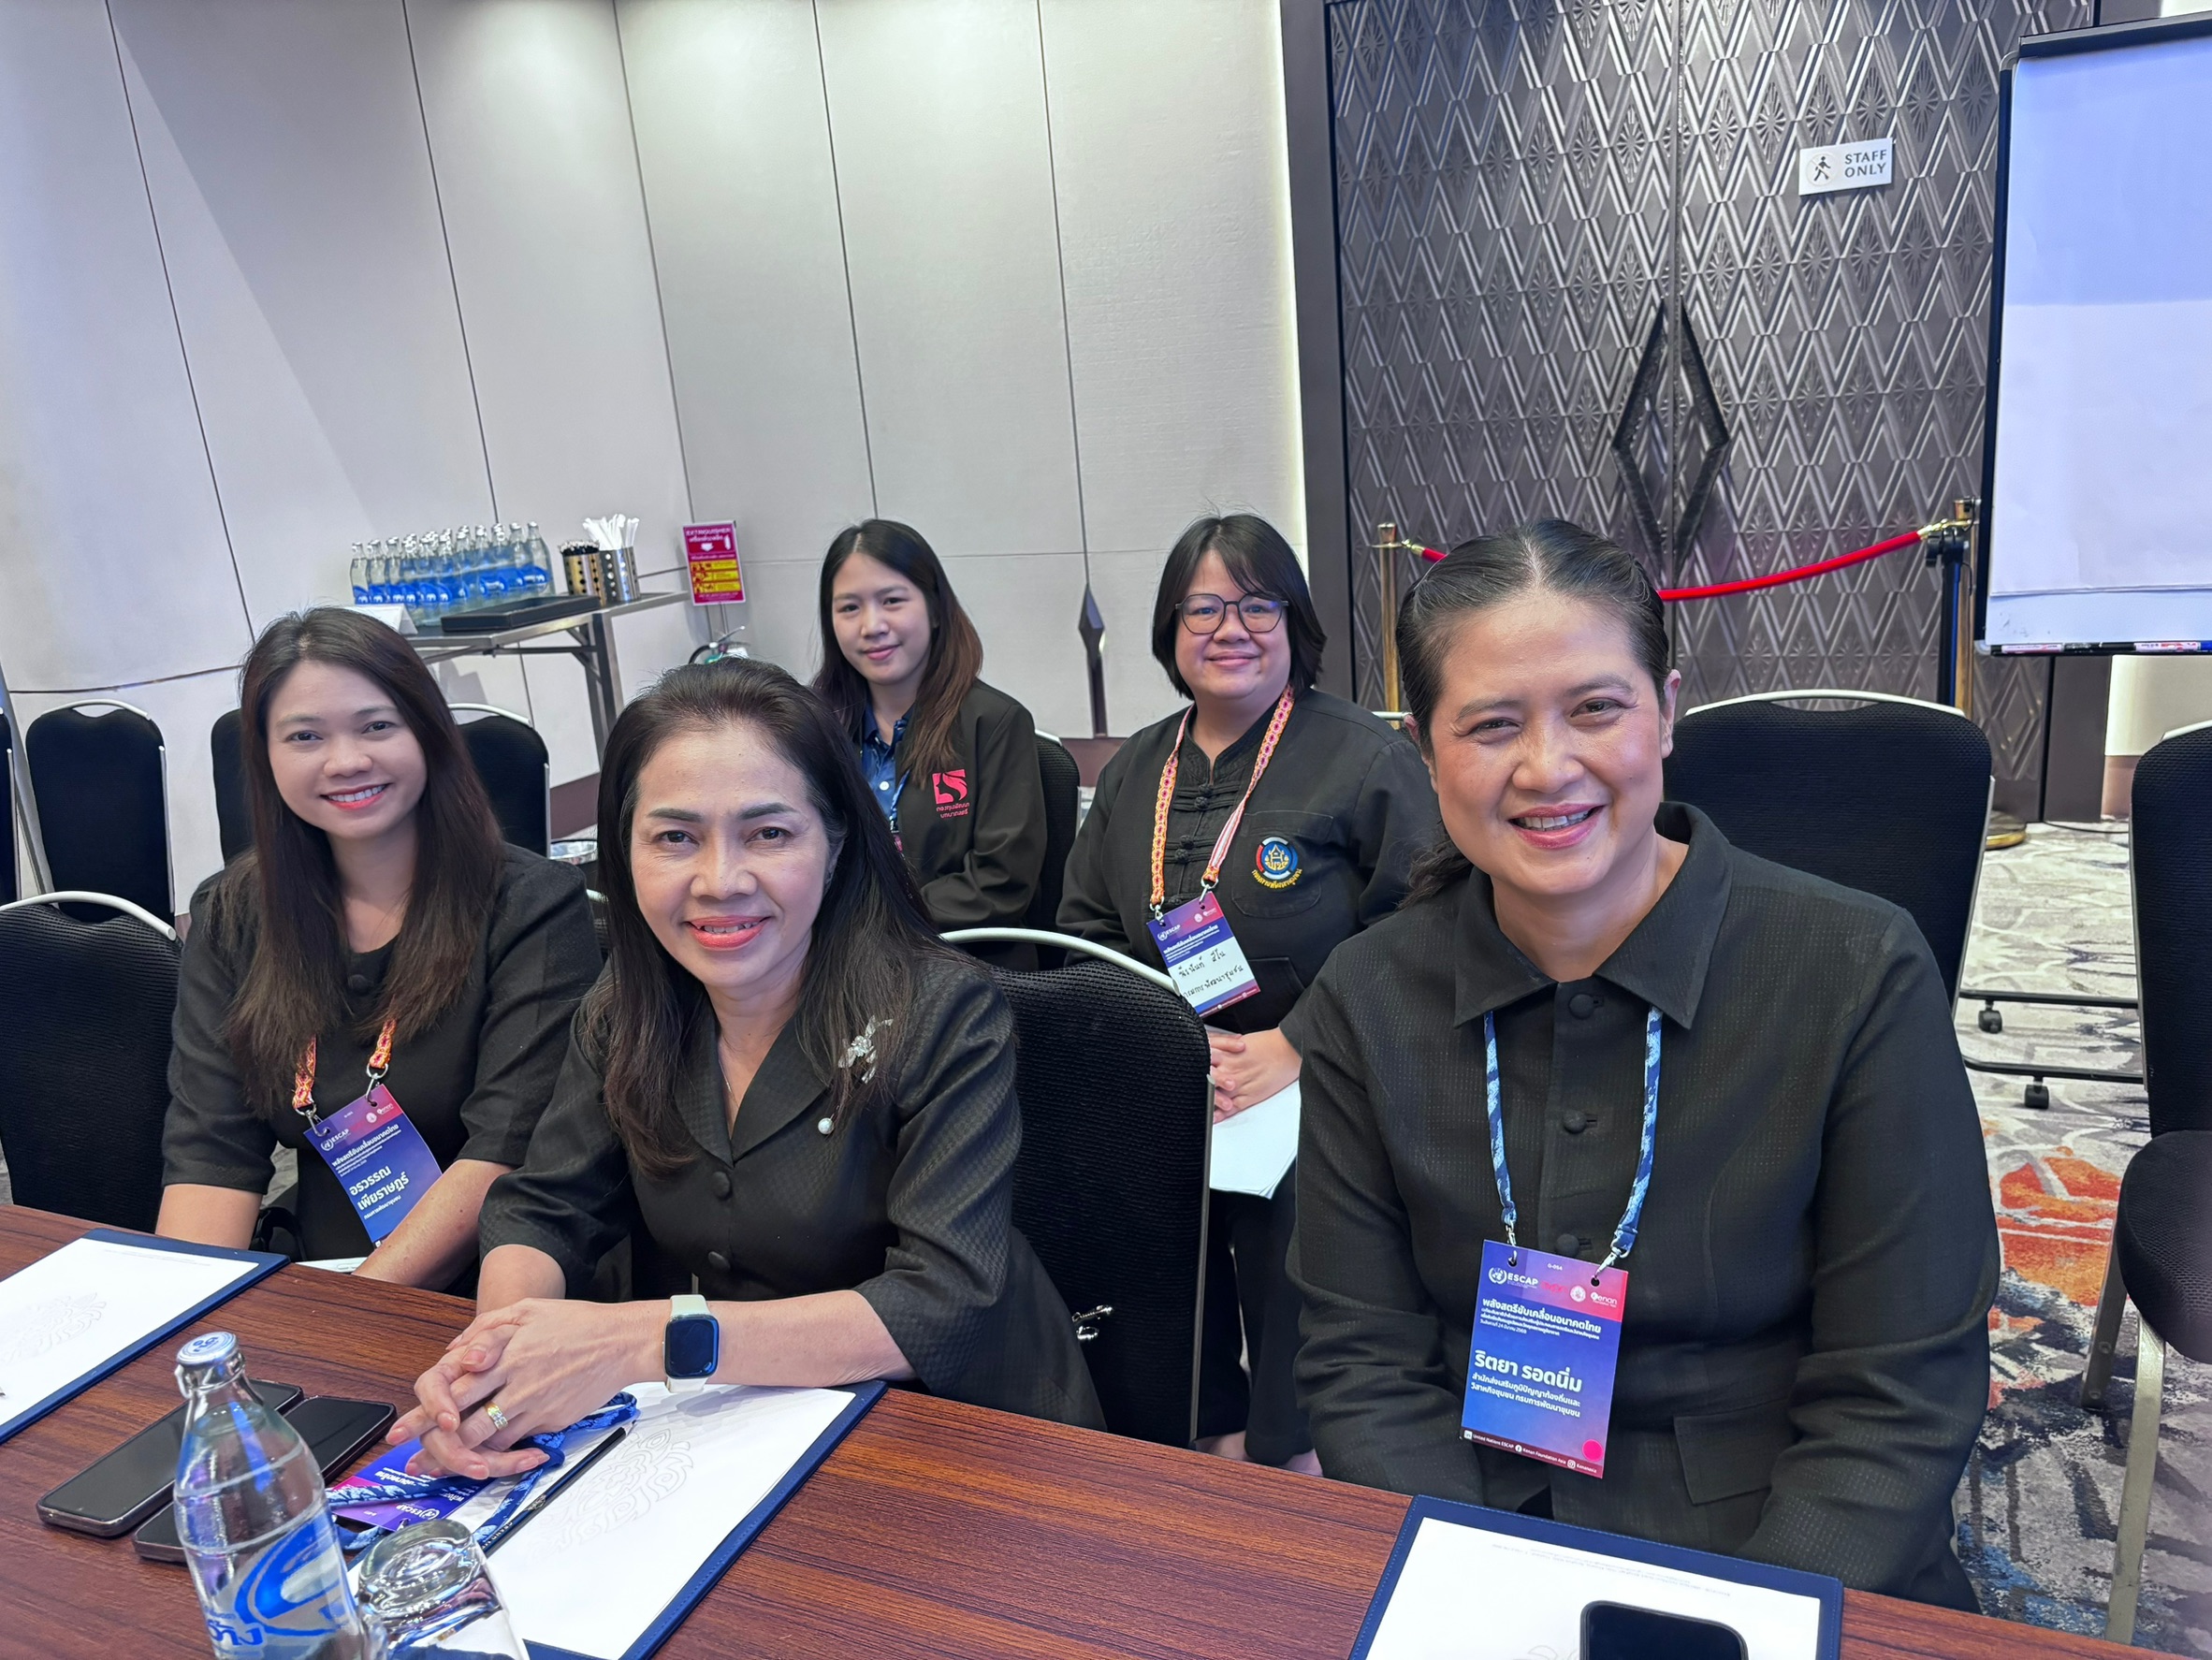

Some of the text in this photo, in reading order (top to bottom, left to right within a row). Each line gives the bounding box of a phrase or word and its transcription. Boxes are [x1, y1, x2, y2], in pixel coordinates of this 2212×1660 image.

[1844, 149, 1887, 165] STAFF
[1844, 163, 1886, 178] ONLY
[332, 1128, 350, 1143] ESCAP
[349, 1164, 392, 1196] อรวรรณ
[357, 1171, 410, 1211] เพียราษฎร์
[1507, 1273, 1538, 1287] ESCAP
[1482, 1297, 1602, 1333] พลังสตรีขับเคลื่อนอนาคตไทย
[1474, 1349, 1582, 1392] ริตยา รอดนิ่ม
[1471, 1382, 1581, 1418] วิสาหกิจชุมชน กรมการพัฒนาชุมชน
[1472, 1372, 1581, 1407] สำนักส่งเสริมภูมิปัญญาท้องถิ่นและ
[1522, 1448, 1535, 1456] Kenan
[1535, 1450, 1557, 1463] Foundation
[396, 1504, 422, 1516] ESCAP
